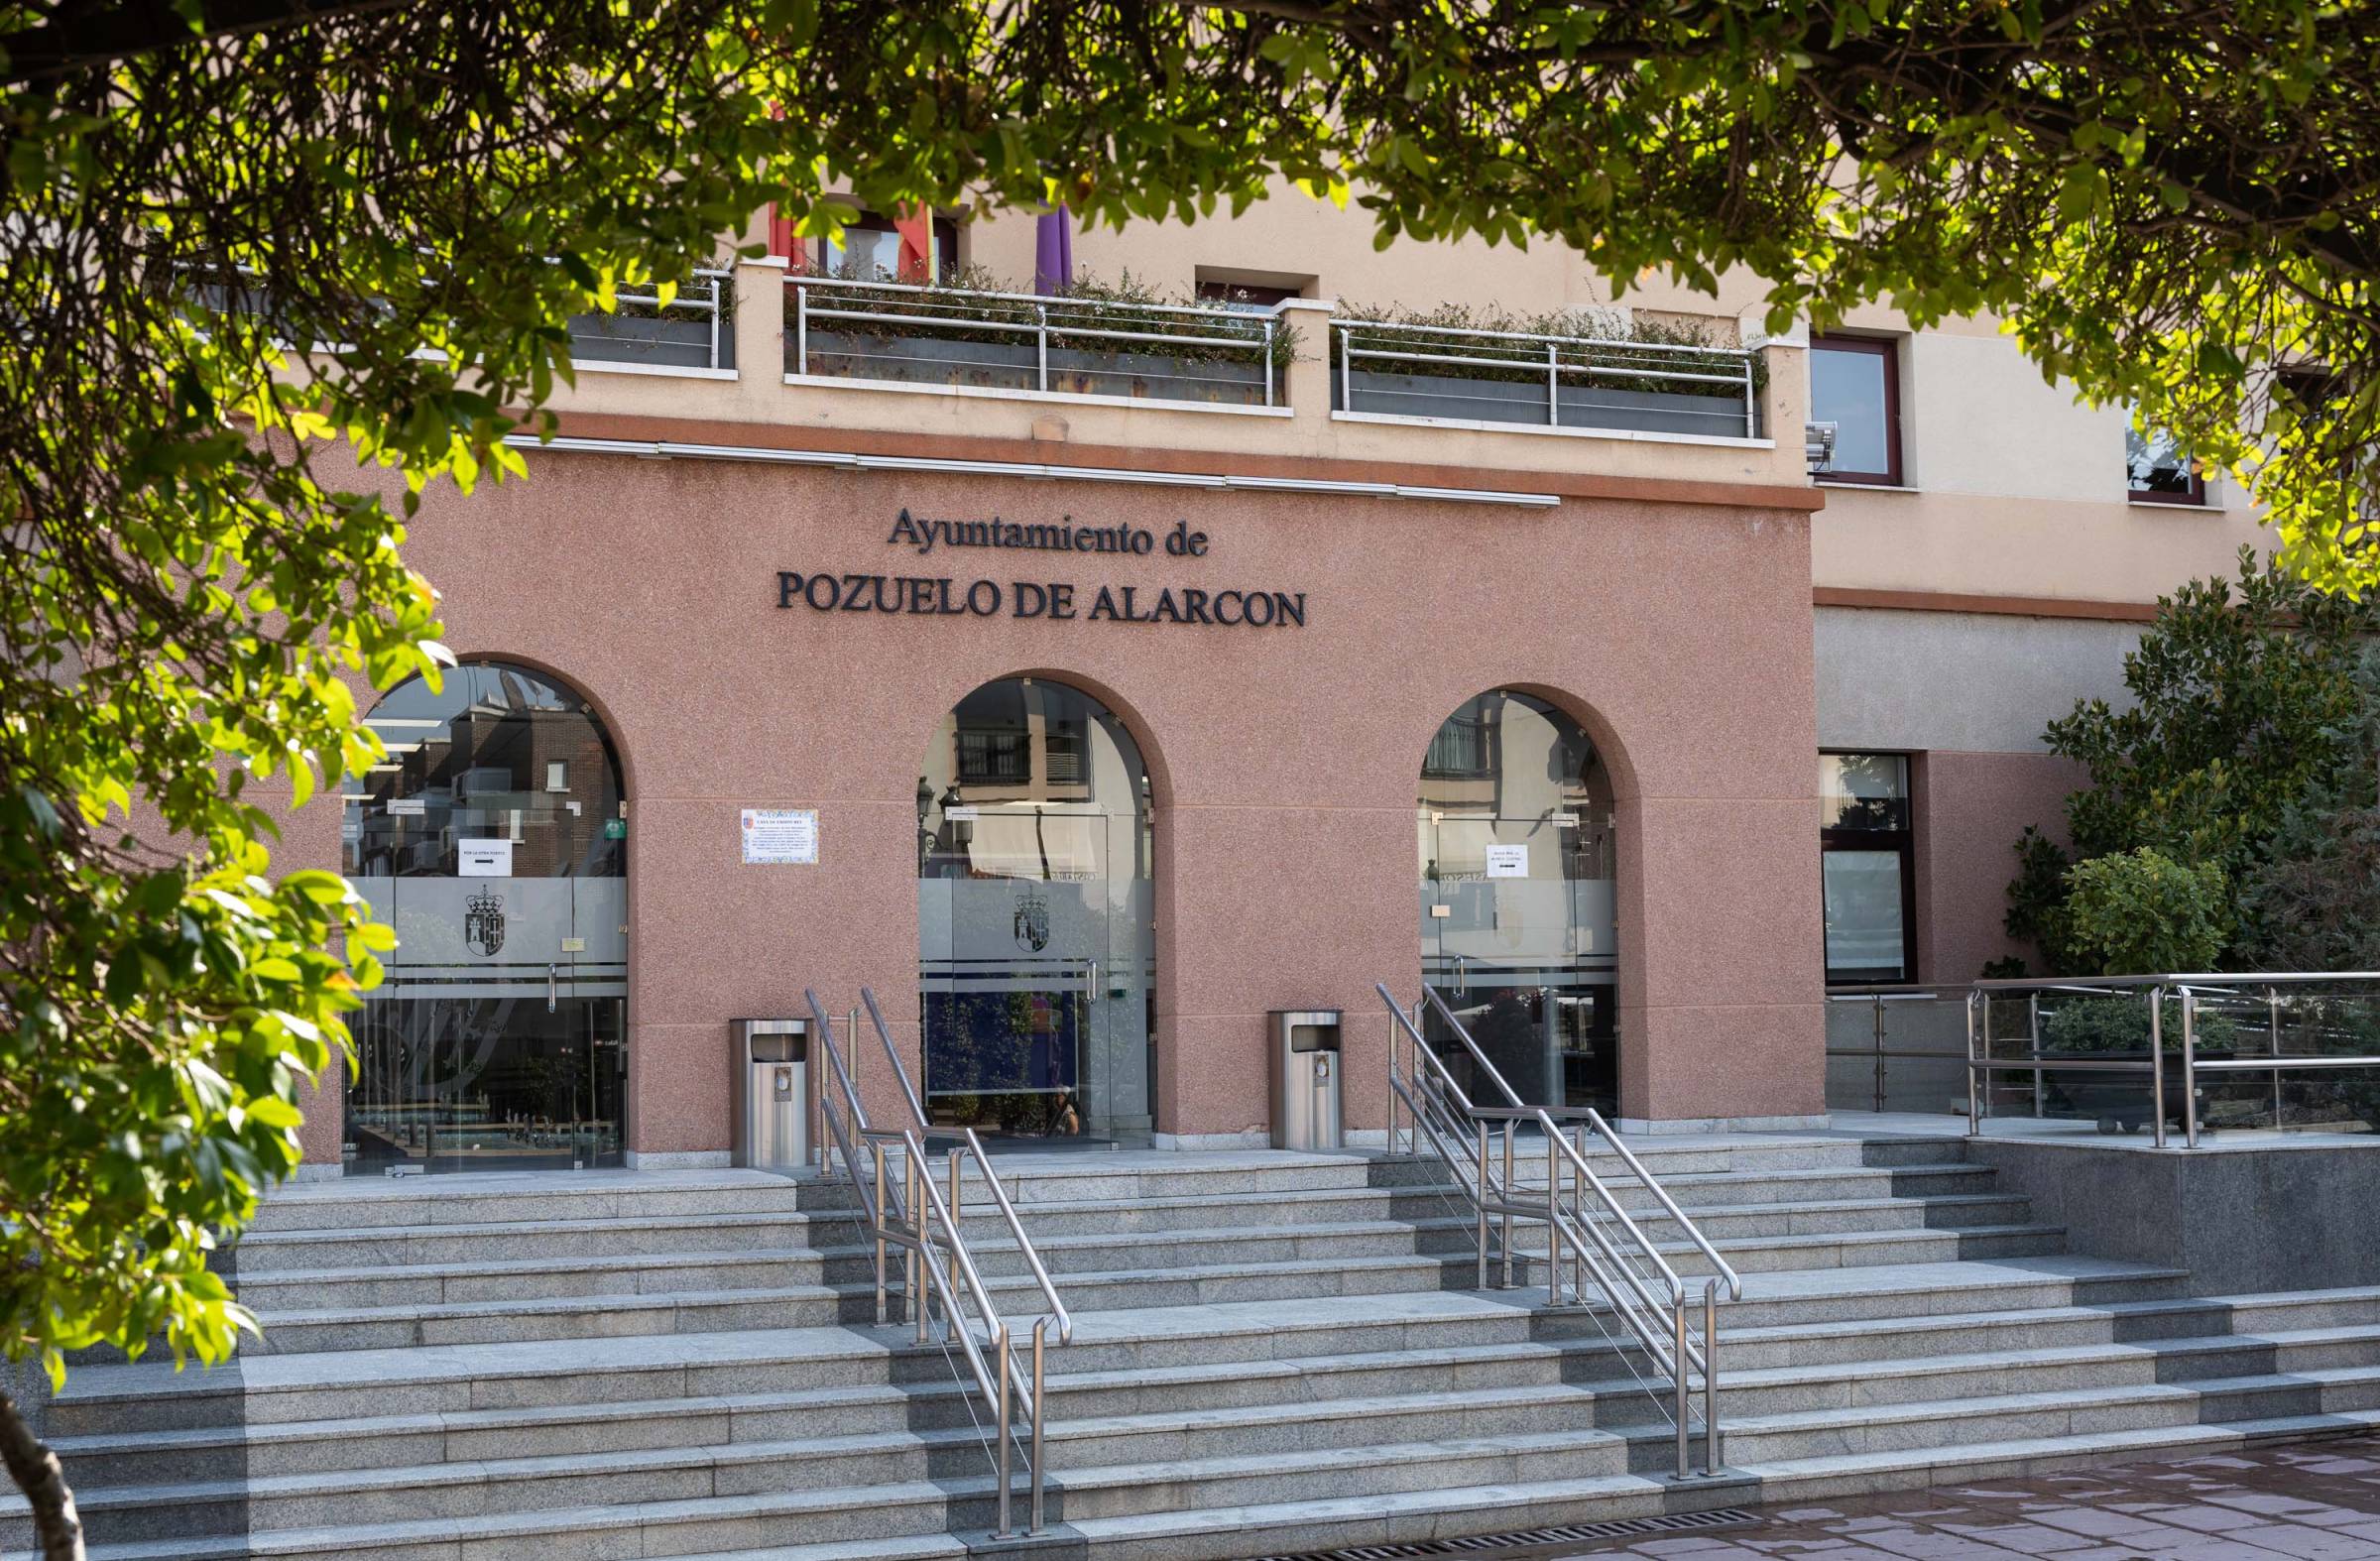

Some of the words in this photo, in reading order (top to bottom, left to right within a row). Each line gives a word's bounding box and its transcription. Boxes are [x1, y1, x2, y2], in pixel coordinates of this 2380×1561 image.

[888, 508, 1153, 554] Ayuntamiento
[1165, 520, 1209, 556] de
[776, 571, 1002, 617] POZUELO
[1012, 581, 1077, 619] DE
[1088, 586, 1307, 628] ALARCON
